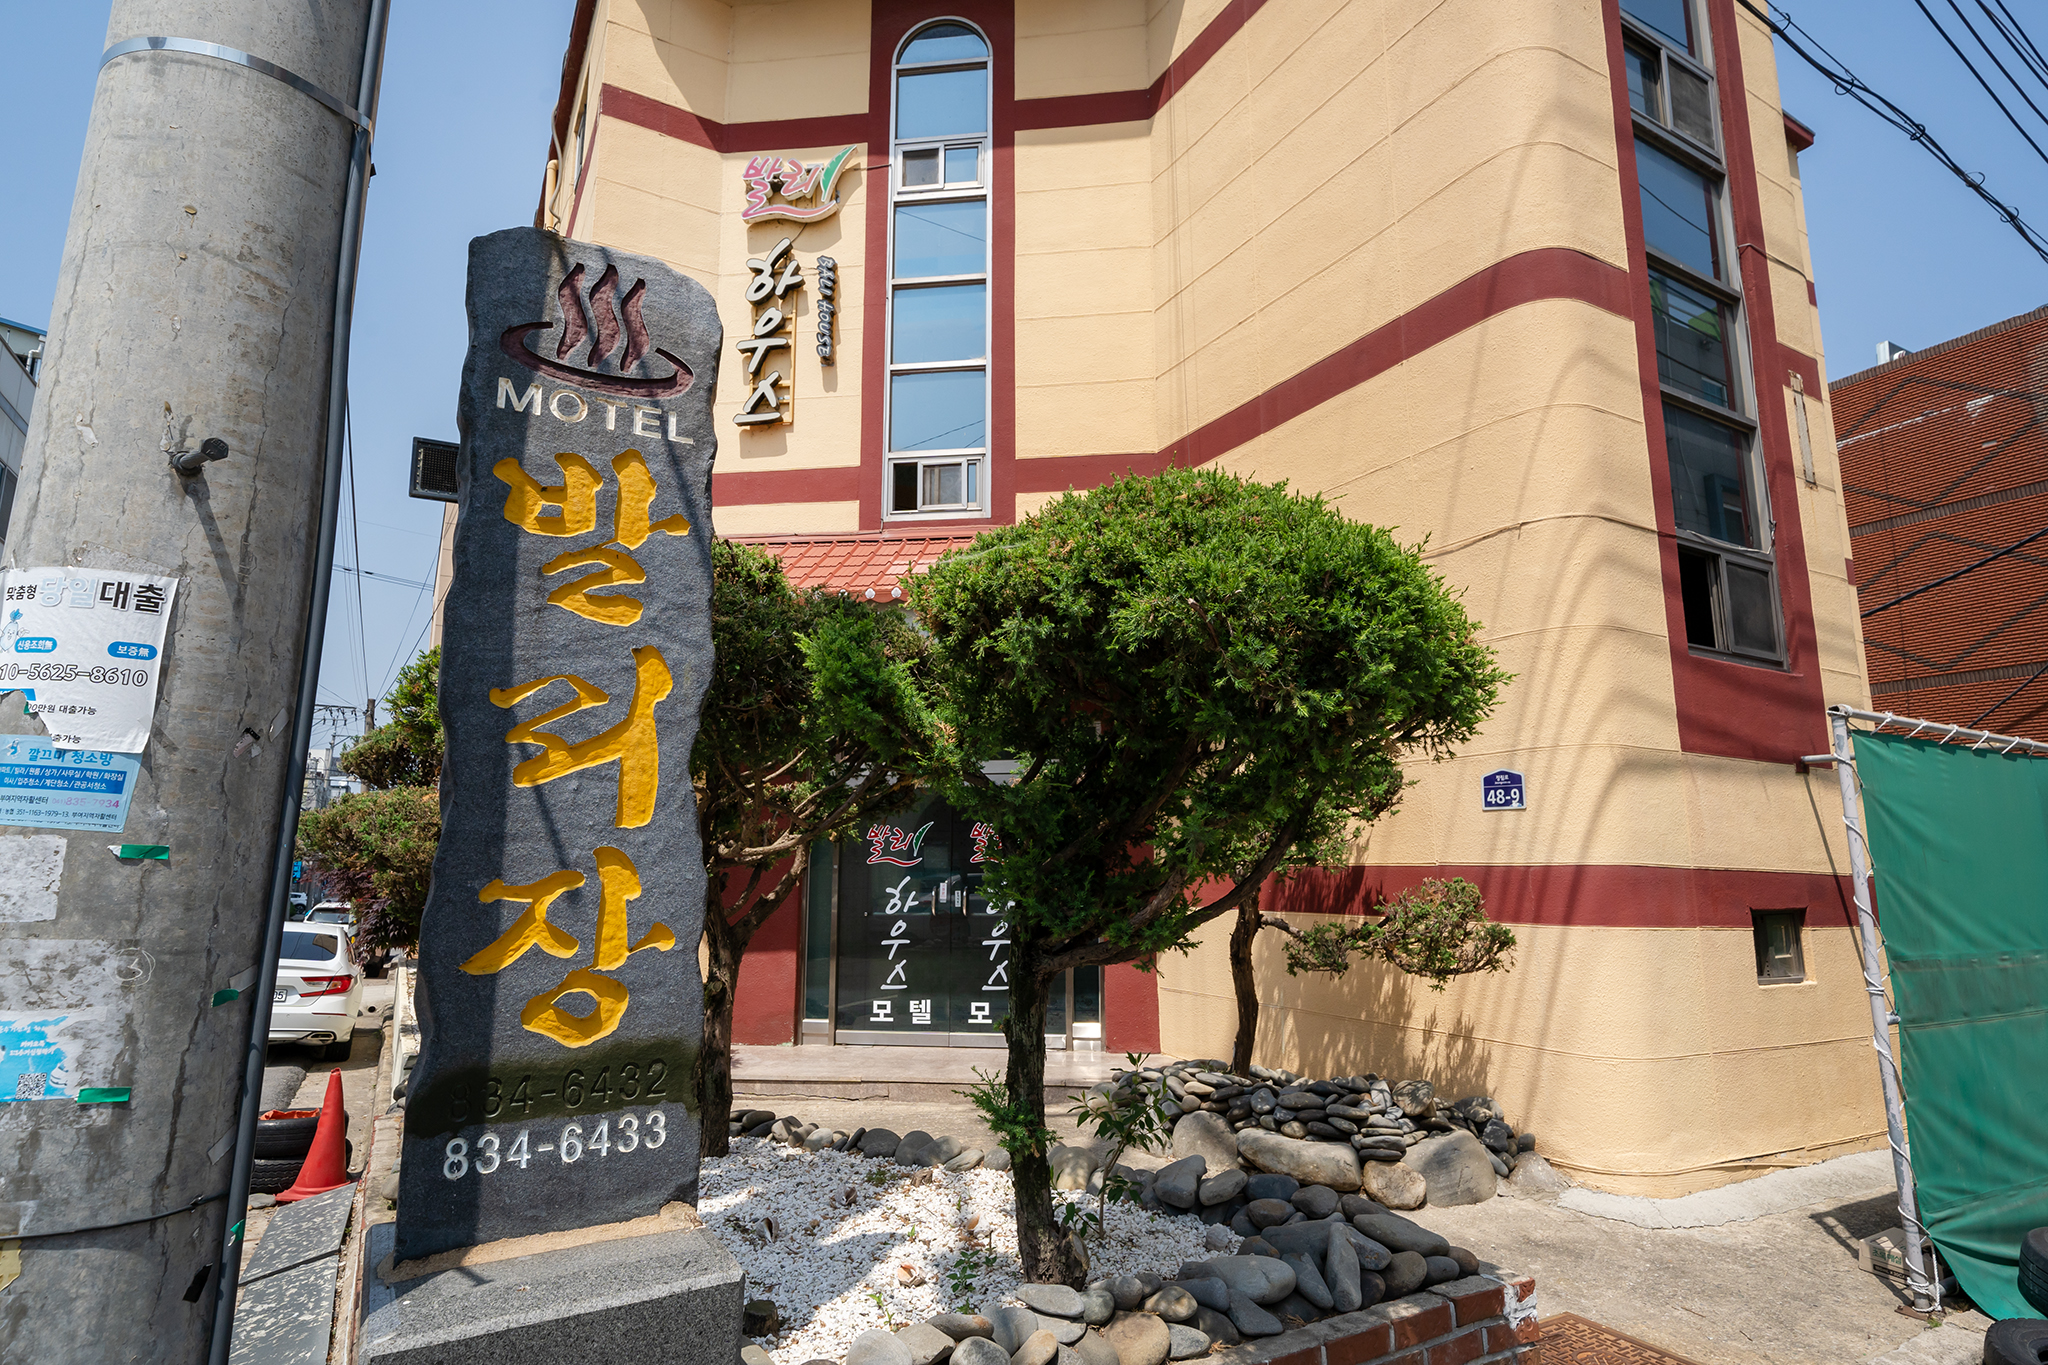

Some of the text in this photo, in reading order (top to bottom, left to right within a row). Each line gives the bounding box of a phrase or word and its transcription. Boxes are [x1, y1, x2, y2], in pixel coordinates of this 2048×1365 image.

[742, 155, 837, 220] 발리
[816, 255, 838, 358] BALI HOUSE
[733, 237, 804, 427] 하우스
[496, 376, 695, 445] MOTEL
[6, 584, 37, 601] 맞춤형
[116, 645, 150, 657] 보증無
[58, 705, 97, 716] 대출가능
[50, 734, 82, 744] 출가능
[71, 751, 114, 766] 청소방
[458, 448, 691, 1049] 발리장
[1487, 788, 1520, 805] 48-9
[867, 823, 923, 868] 발리
[881, 875, 919, 990] 하우스
[869, 998, 932, 1025] 모텔
[967, 1002, 993, 1024] 모
[450, 1057, 669, 1122] 834-6432
[443, 1109, 667, 1180] 834-6433
